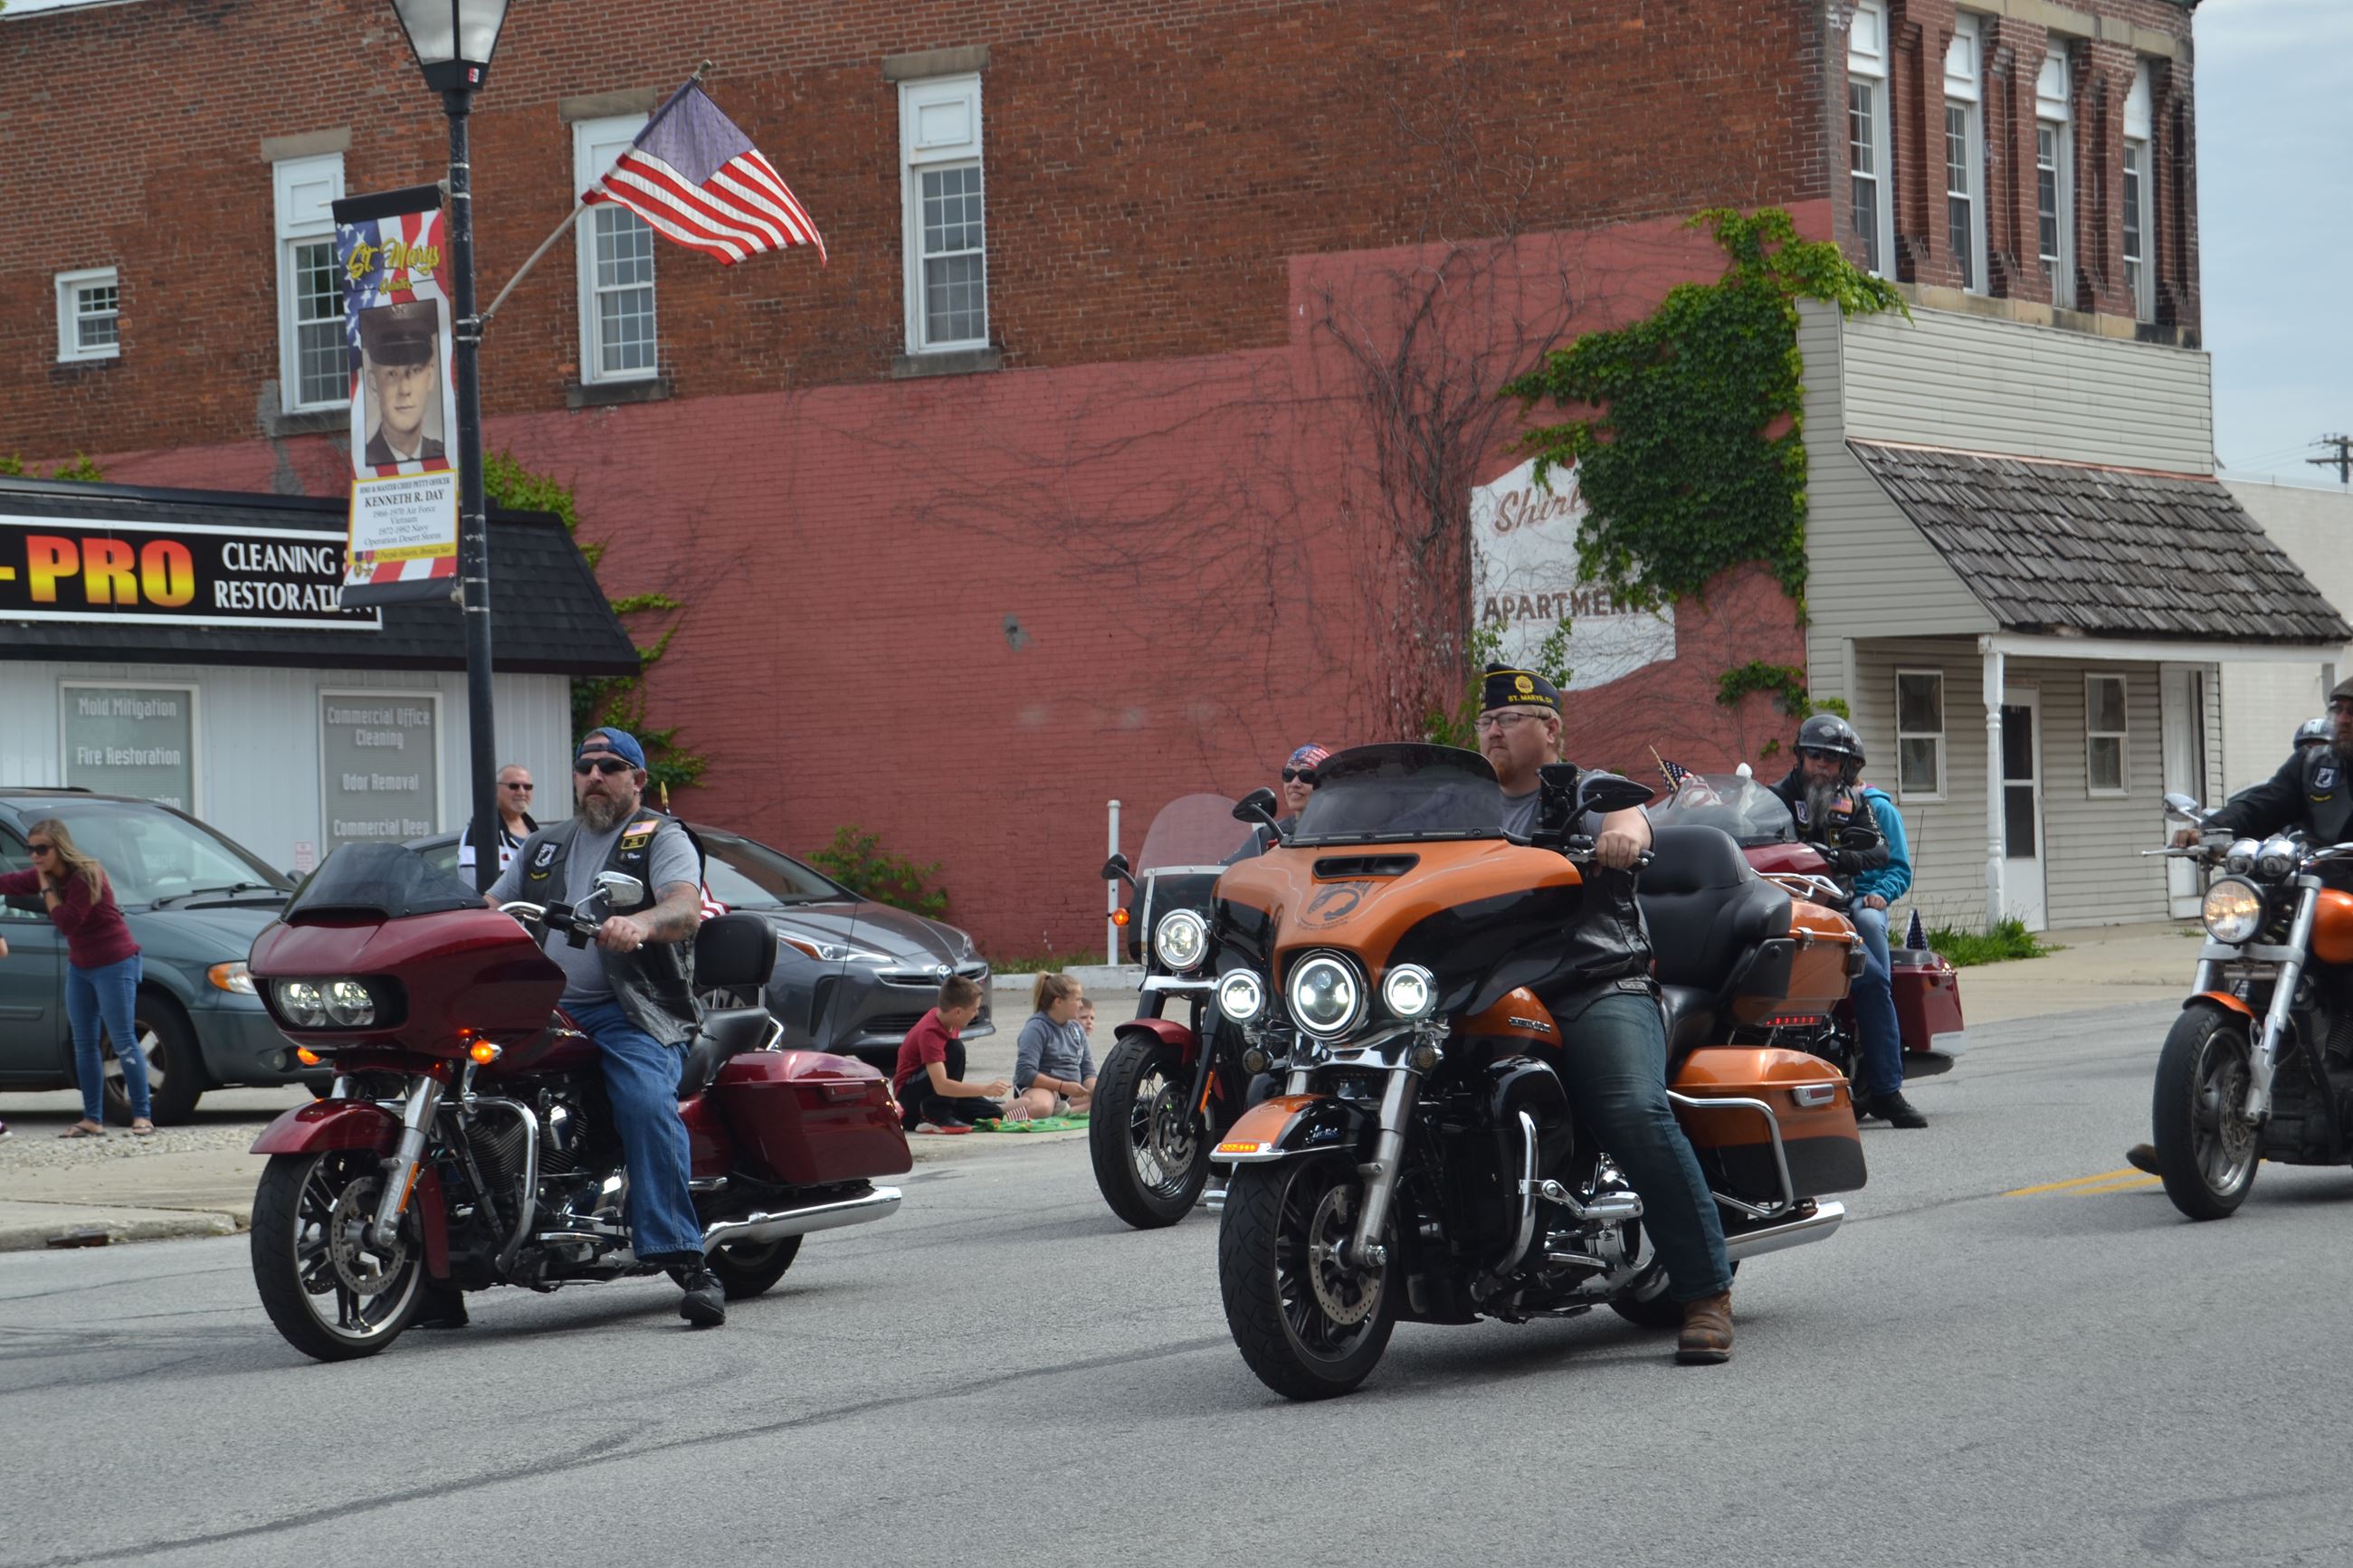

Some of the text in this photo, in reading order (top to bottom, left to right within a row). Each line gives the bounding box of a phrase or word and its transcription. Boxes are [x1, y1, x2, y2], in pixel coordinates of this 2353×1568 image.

[380, 237, 440, 276] Marys
[376, 483, 397, 492] MASTER
[398, 481, 413, 490] CHIEF
[413, 480, 428, 489] PETTY
[428, 477, 450, 487] OFFICER
[365, 489, 444, 508] KENNETH R. DAY
[1494, 484, 1583, 533] Shirl
[406, 507, 417, 515] Air
[418, 506, 436, 514] Force
[390, 517, 418, 525] Vietnam
[412, 525, 429, 533] Navy
[364, 531, 442, 547] Operation Desert Storm
[222, 542, 336, 575] CLEANING
[380, 551, 397, 560] Purple
[420, 546, 438, 555] Bronze
[214, 580, 373, 613] RESTORATI
[1481, 589, 1657, 622] APARTMEN
[78, 697, 177, 720] Mold Mitigation
[327, 706, 431, 727] Commercial Office
[355, 727, 405, 749] Cleaning
[77, 746, 181, 766] Fire Restoration
[342, 773, 420, 791] Odor Removal
[333, 818, 431, 838] Commercial Deep
